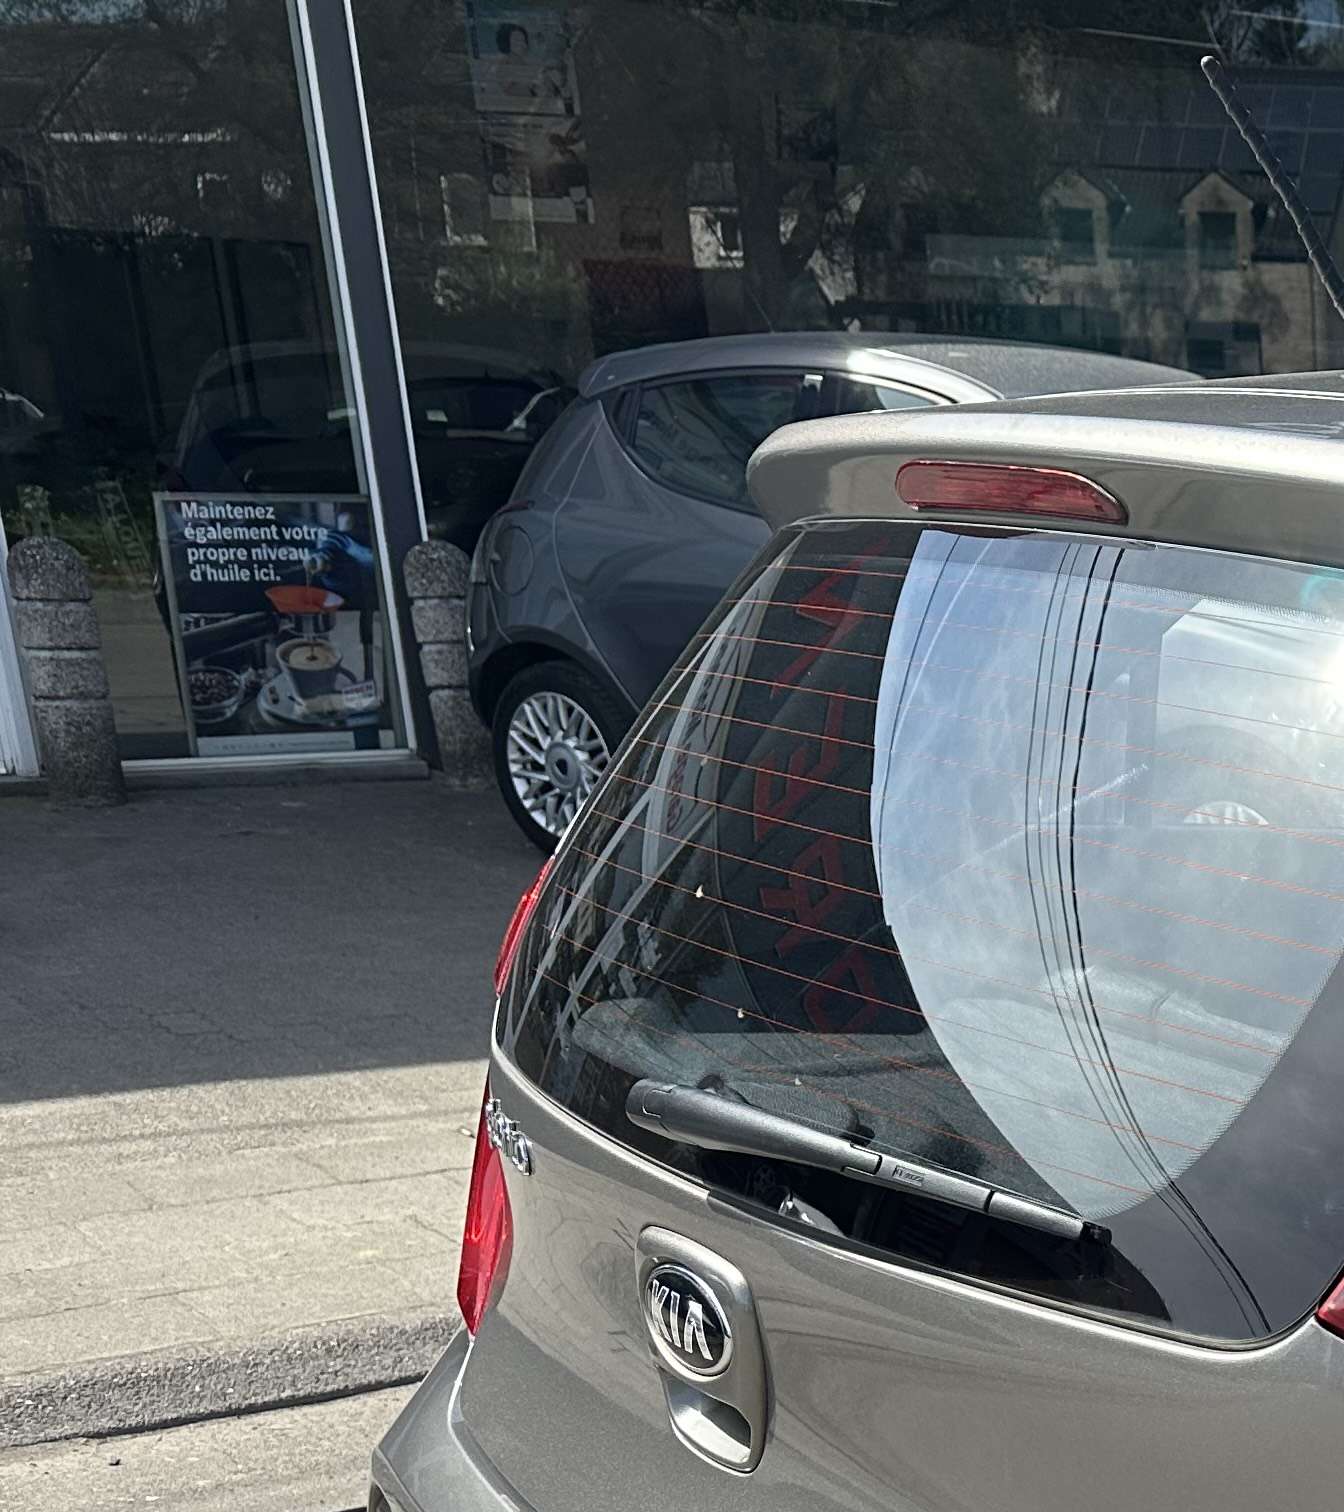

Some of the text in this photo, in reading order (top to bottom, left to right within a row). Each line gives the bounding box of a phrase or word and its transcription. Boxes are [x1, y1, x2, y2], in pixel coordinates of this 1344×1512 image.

[180, 501, 276, 520] Maintenez
[184, 523, 328, 544] également votre
[187, 543, 310, 564] propre niveau
[190, 563, 281, 582] d'huile ici.
[651, 1279, 714, 1361] KIA
